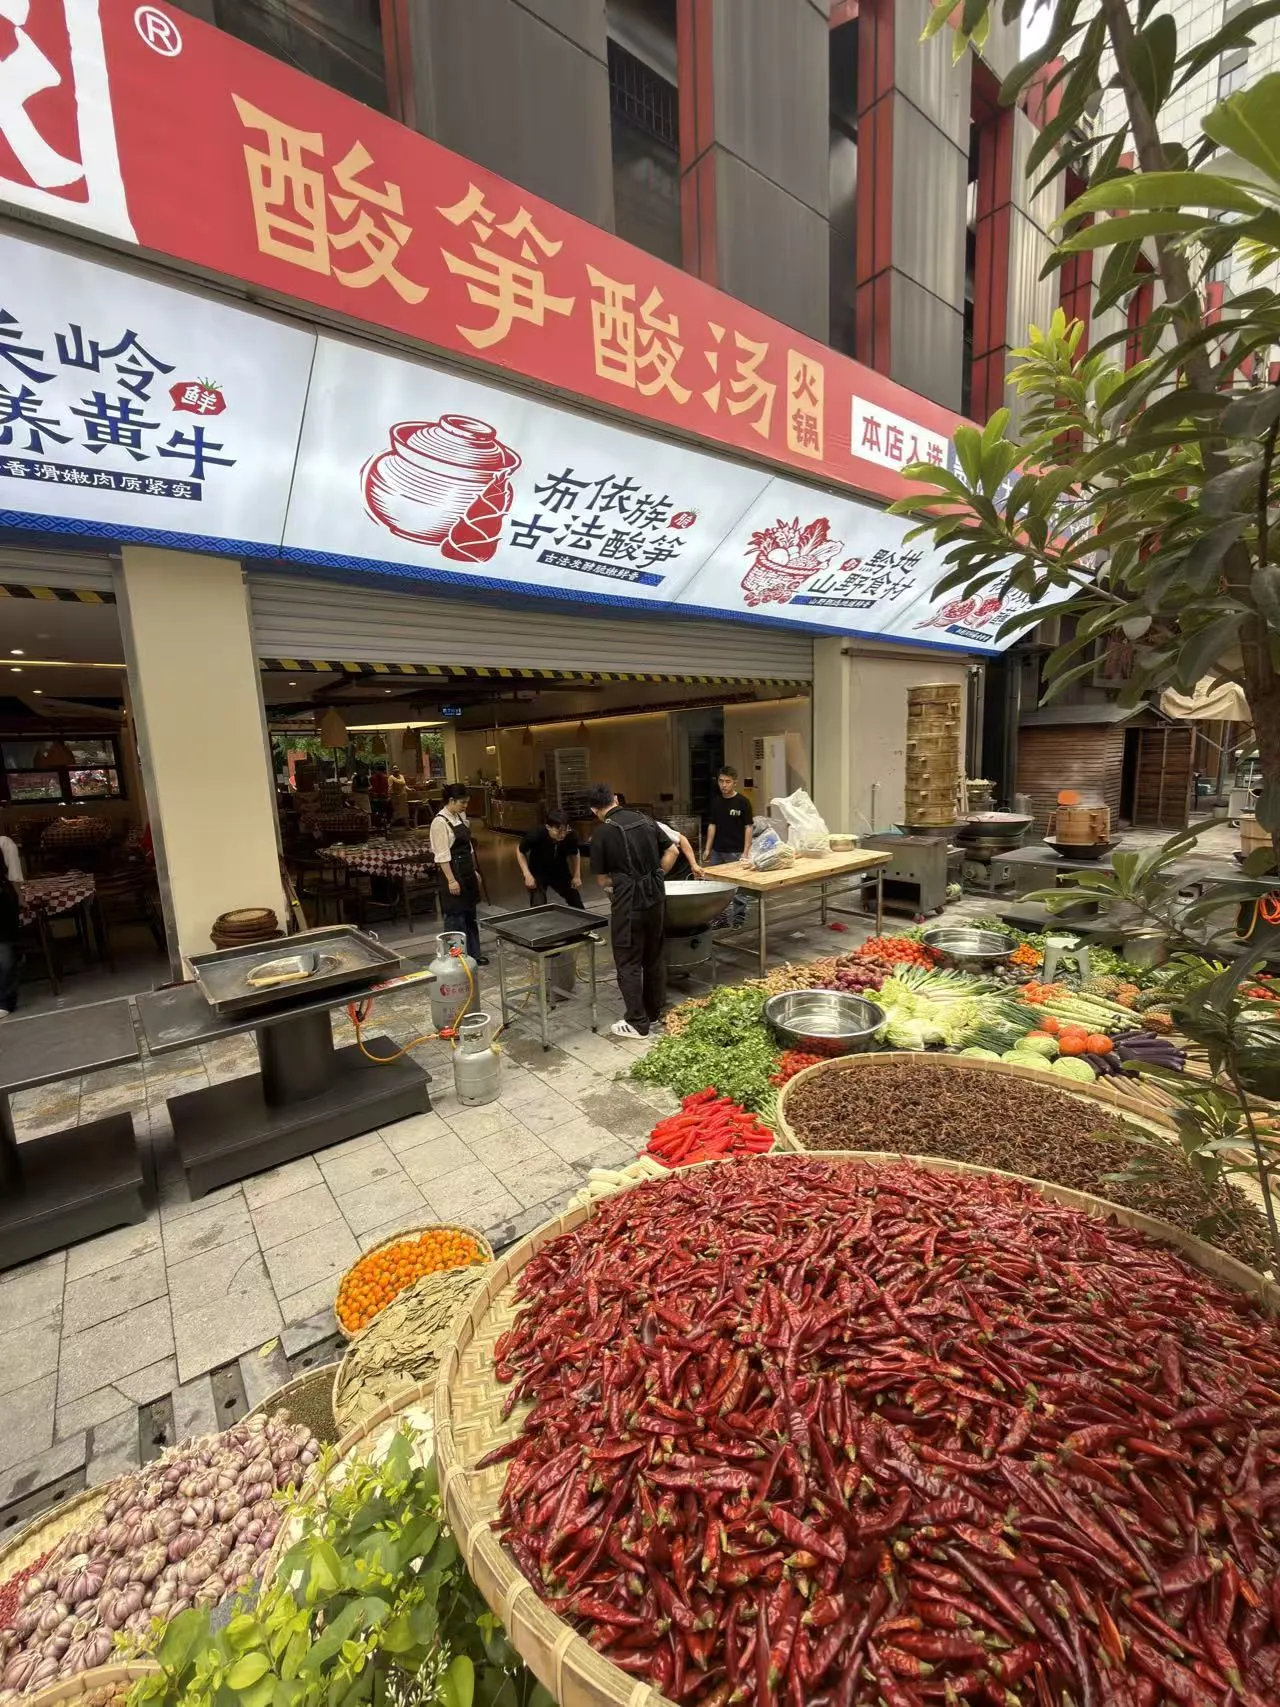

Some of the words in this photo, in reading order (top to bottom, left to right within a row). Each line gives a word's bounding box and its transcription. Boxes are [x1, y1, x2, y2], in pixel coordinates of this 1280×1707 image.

[231, 93, 777, 440] 酸笋酸汤
[181, 385, 217, 413] 鲜
[791, 363, 821, 452] 火锅
[861, 415, 943, 466] 本店入选
[534, 467, 674, 532] 布依族
[509, 514, 687, 569] 古法酸笋
[859, 549, 924, 576] 黔地
[807, 571, 916, 601] 山野食材
